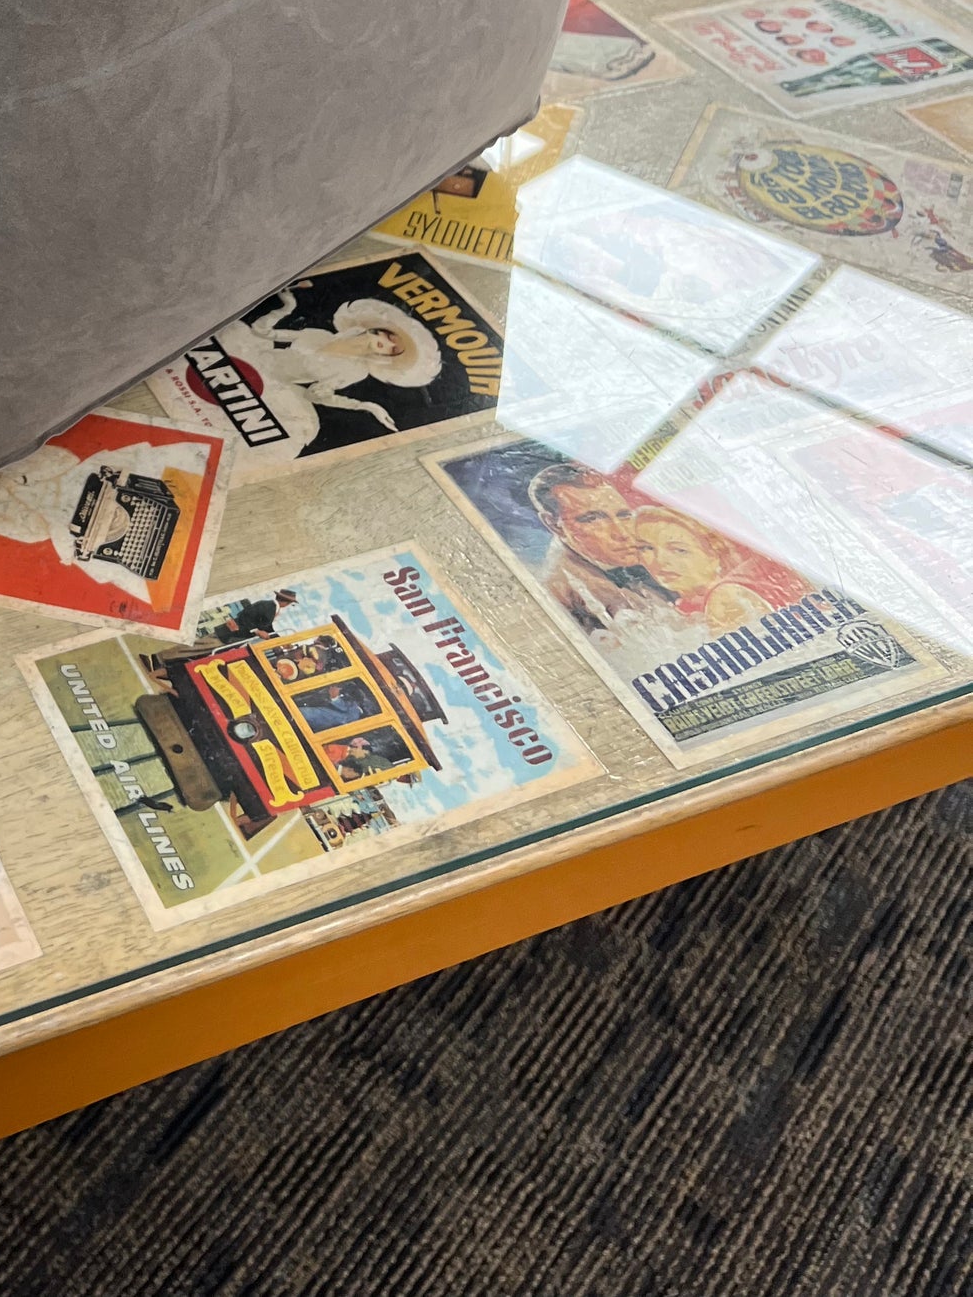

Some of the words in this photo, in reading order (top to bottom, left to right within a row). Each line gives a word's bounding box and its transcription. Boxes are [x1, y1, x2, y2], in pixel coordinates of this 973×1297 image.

[828, 194, 860, 216] 80
[170, 374, 191, 400] ROSSI
[184, 339, 281, 441] ARTINI
[383, 565, 437, 624] San
[423, 610, 555, 768] Francisco
[631, 586, 869, 713] CASABLANCA
[58, 662, 120, 751] UNITED
[110, 758, 149, 806] AIR
[137, 811, 196, 892] LINES
